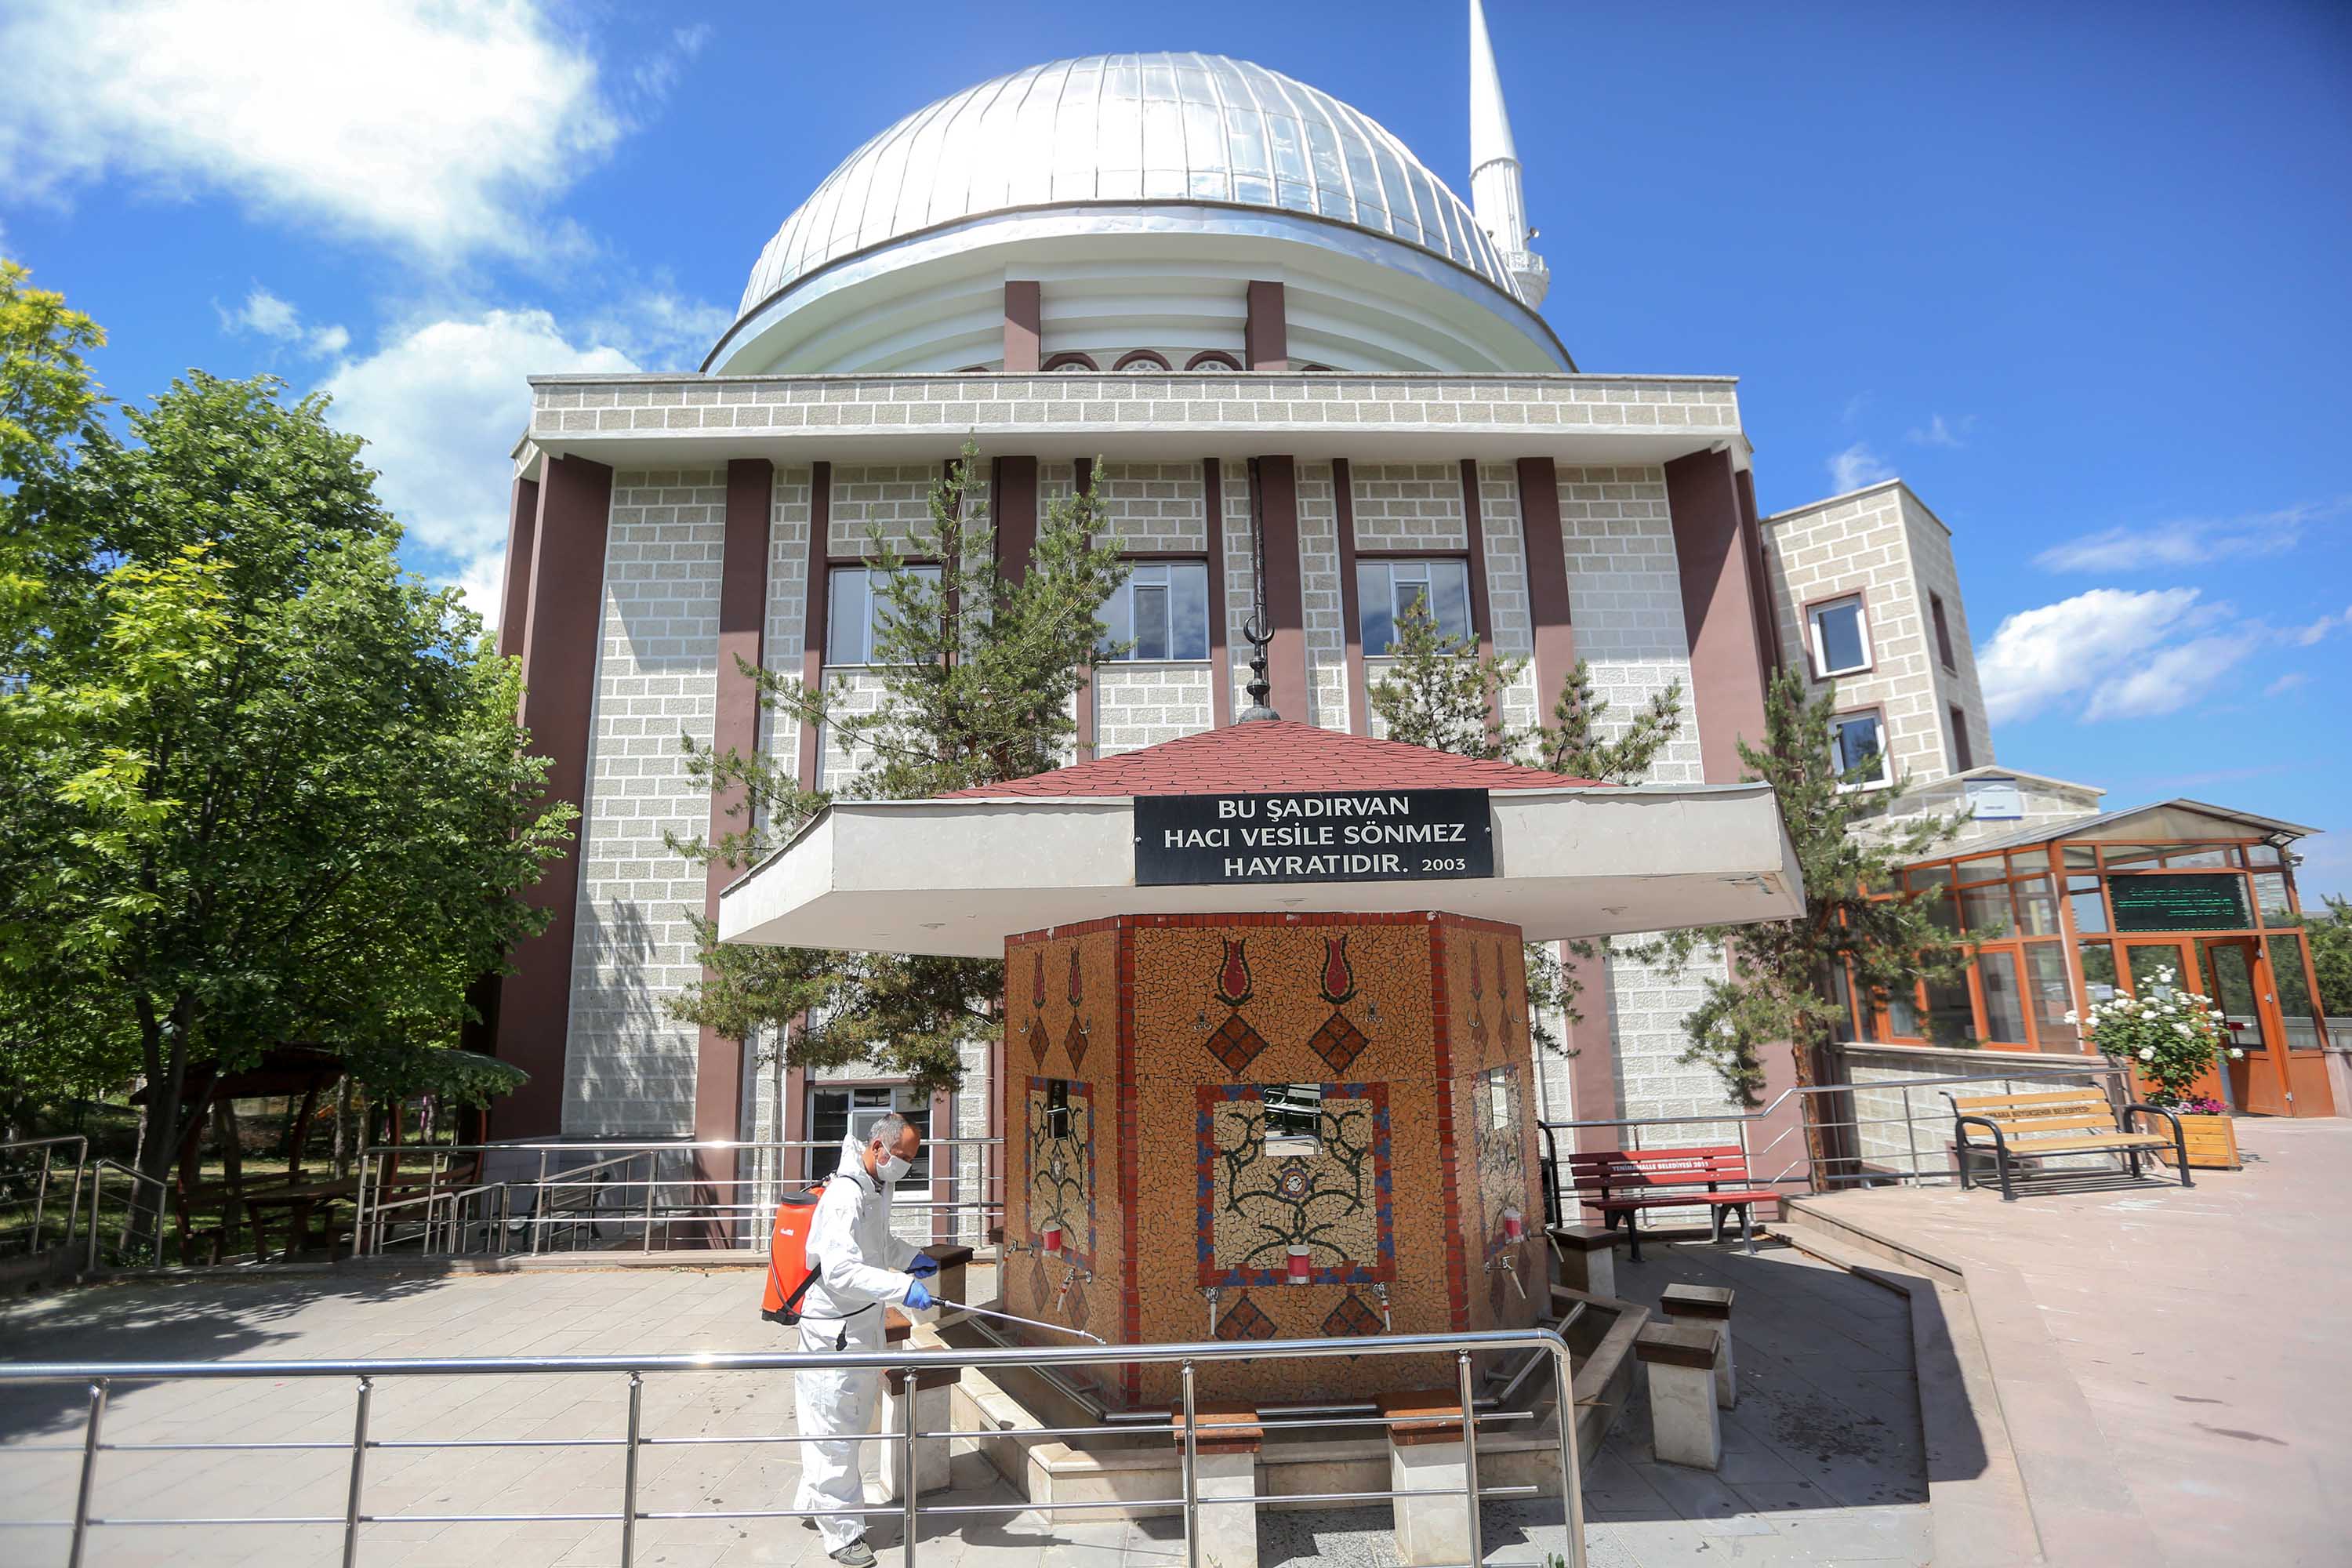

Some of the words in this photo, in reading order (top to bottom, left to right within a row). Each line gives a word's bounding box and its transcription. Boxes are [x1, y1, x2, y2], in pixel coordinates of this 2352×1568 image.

[1218, 800, 1255, 819] BU
[1267, 797, 1410, 822] ŞADIRVAN
[1164, 828, 1230, 848] HACI
[1240, 822, 1334, 847] VESİLE
[1344, 821, 1466, 844] SÖNMEZ
[1225, 853, 1409, 877] HAYRATIDIR.
[1421, 858, 1466, 872] 2003
